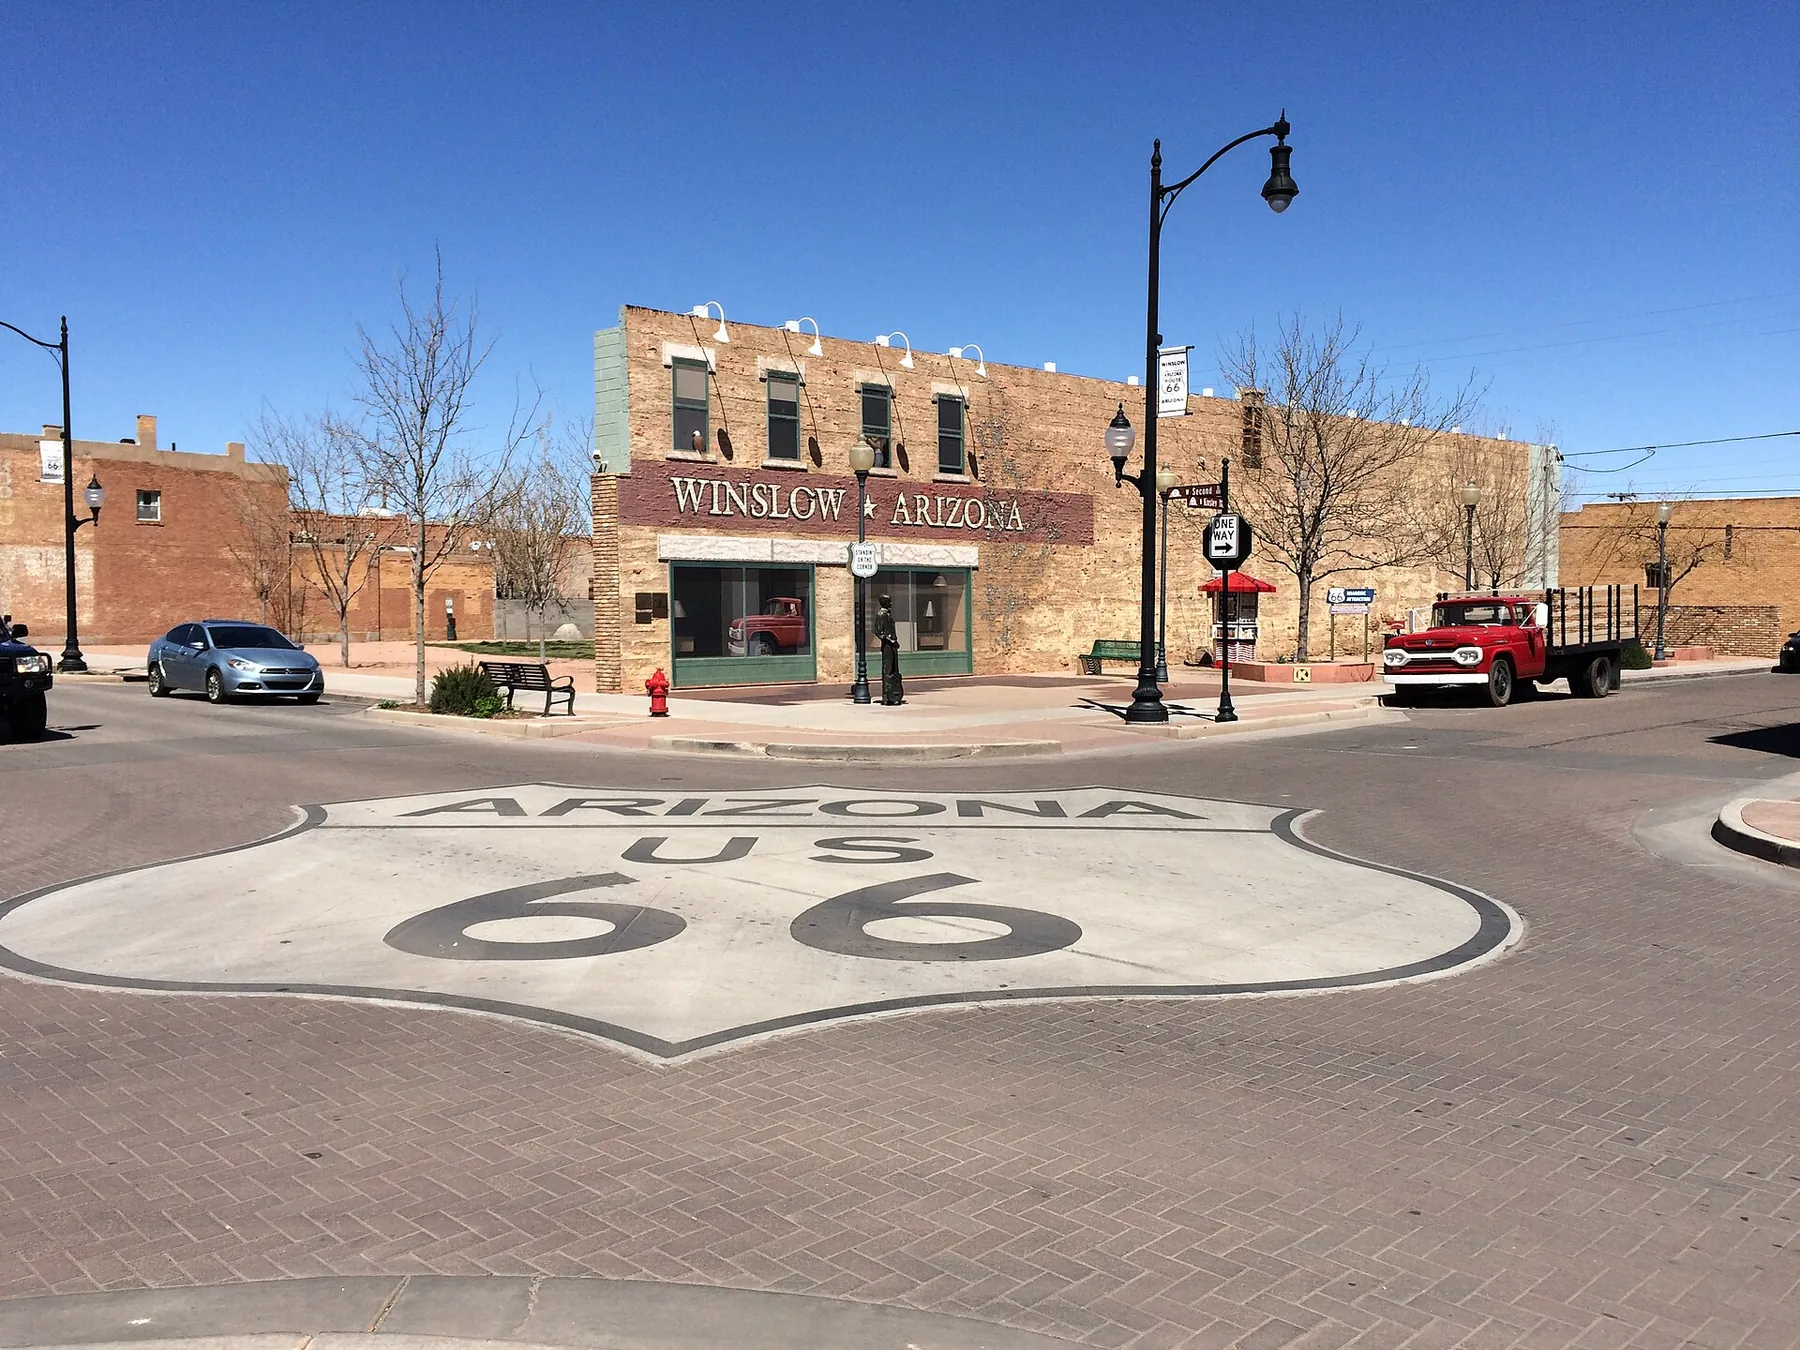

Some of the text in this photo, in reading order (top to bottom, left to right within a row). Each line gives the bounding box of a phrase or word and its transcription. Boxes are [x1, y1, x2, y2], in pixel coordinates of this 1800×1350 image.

[1166, 383, 1180, 393] 66
[47, 461, 59, 470] 66
[1192, 486, 1213, 496] Second
[670, 477, 847, 522] WINSLOW
[890, 491, 1024, 531] ARIZONA
[1214, 518, 1235, 529] ONE
[1213, 530, 1235, 541] WAY
[1330, 592, 1343, 602] 66
[395, 798, 1207, 820] ARIZONA
[384, 872, 1083, 961] 66
